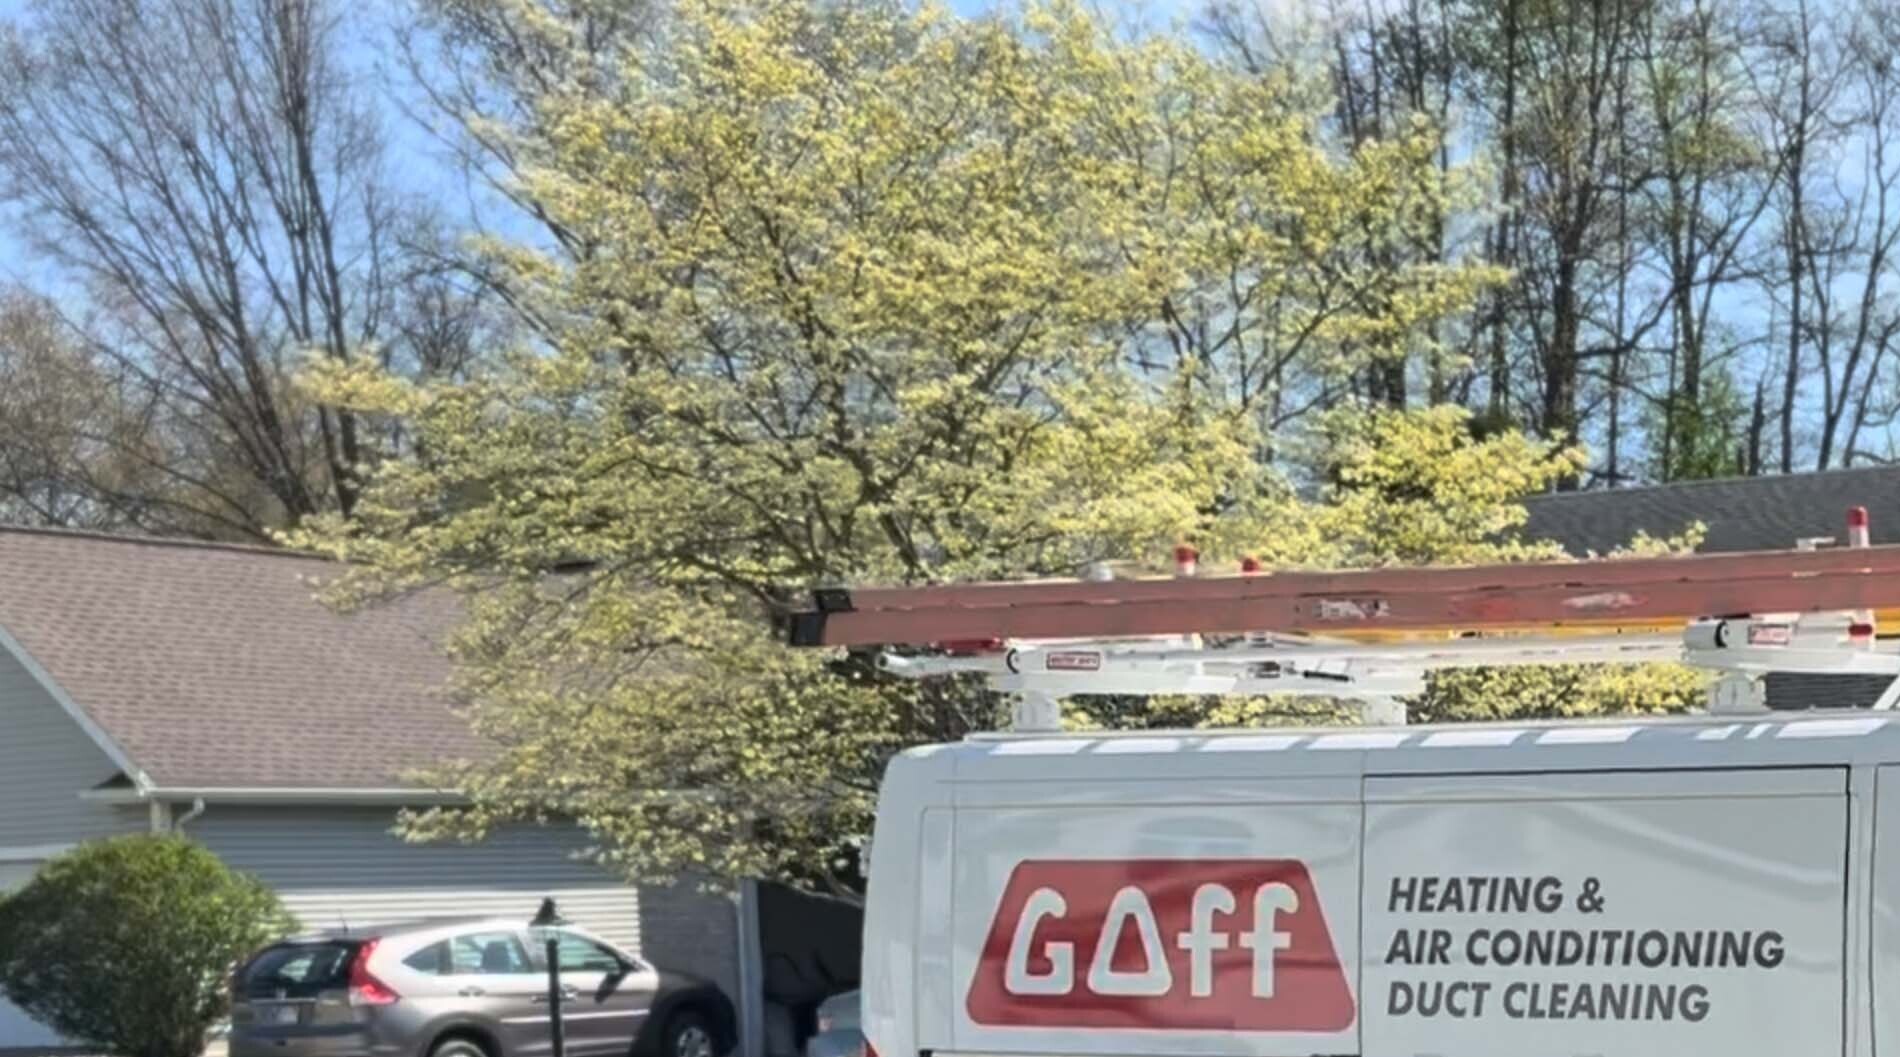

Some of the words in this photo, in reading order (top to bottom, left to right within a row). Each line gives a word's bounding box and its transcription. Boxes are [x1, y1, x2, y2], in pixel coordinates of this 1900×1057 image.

[1387, 876, 1563, 914] HEATING
[1576, 876, 1605, 914] &
[1384, 928, 1453, 966] AIR
[1465, 929, 1786, 969] CONDITIONING
[1387, 981, 1491, 1018] DUCT
[1502, 983, 1711, 1023] CLEANING
